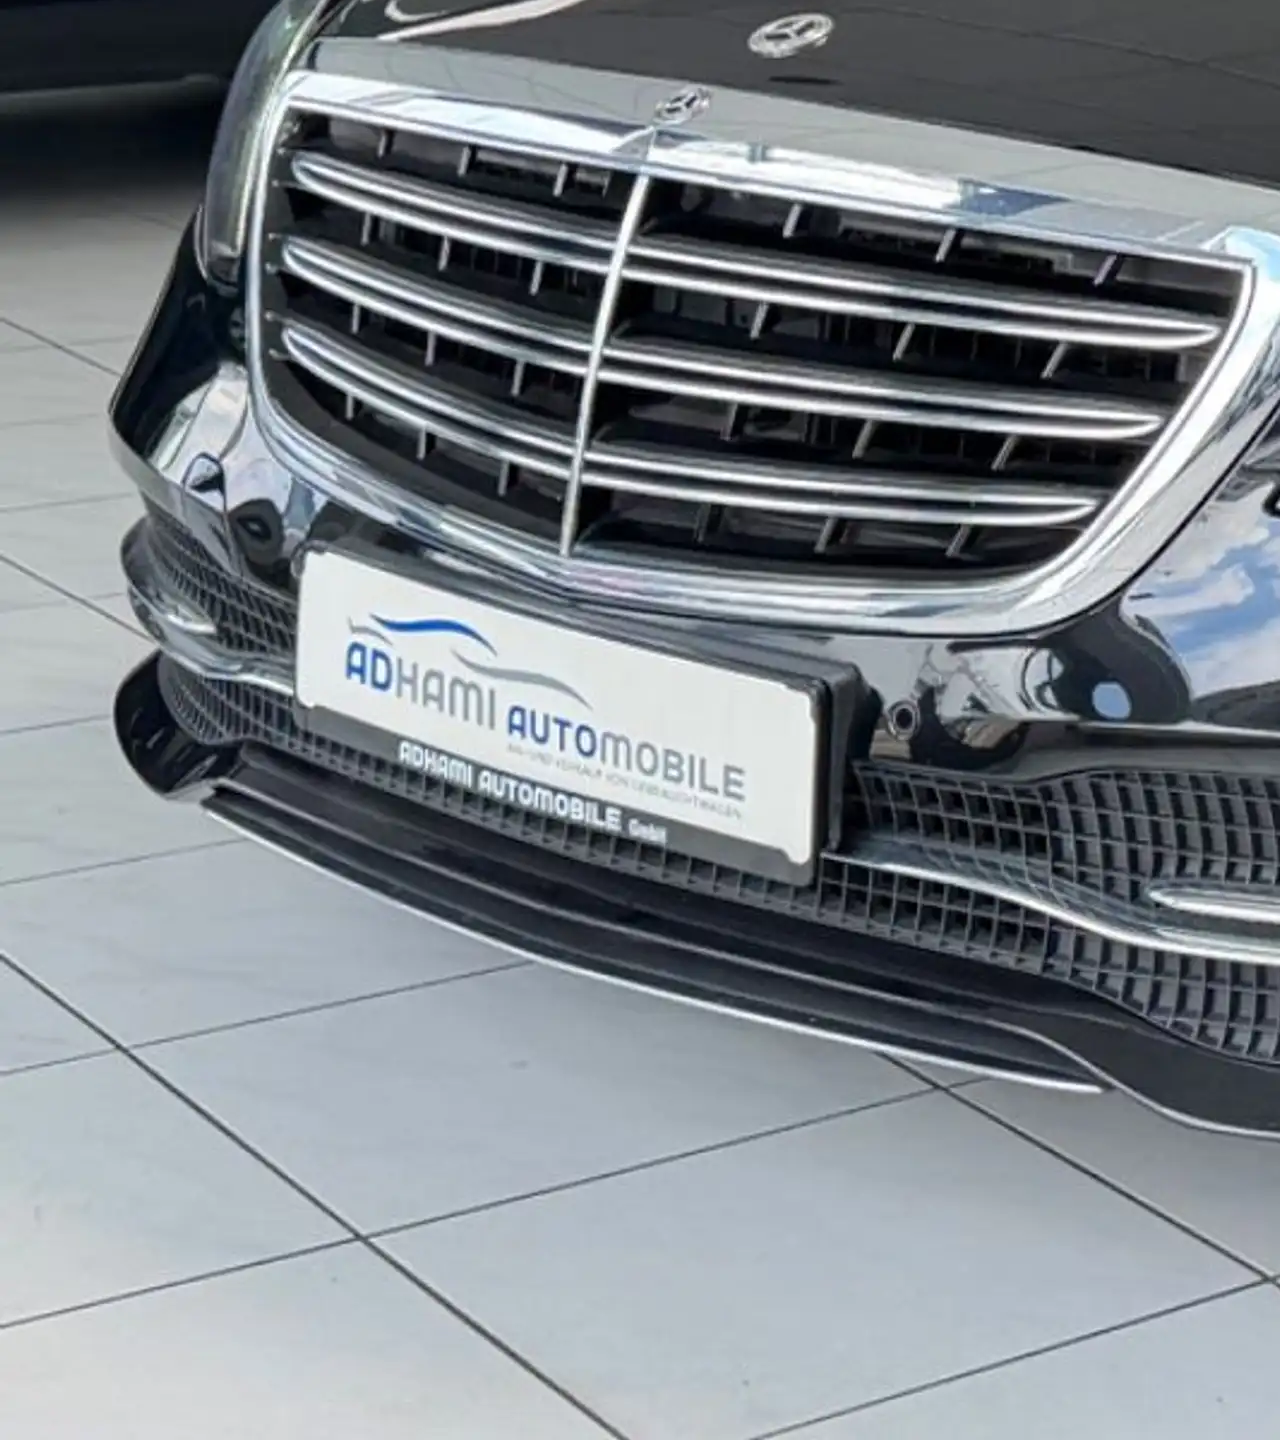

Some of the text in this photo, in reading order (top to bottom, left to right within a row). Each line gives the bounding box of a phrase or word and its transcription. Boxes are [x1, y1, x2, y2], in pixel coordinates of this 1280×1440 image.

[346, 641, 746, 801] ADHAMI AUTOMOBILE
[399, 740, 473, 788] ADHAMI
[478, 770, 622, 832] AUTOMOBILE
